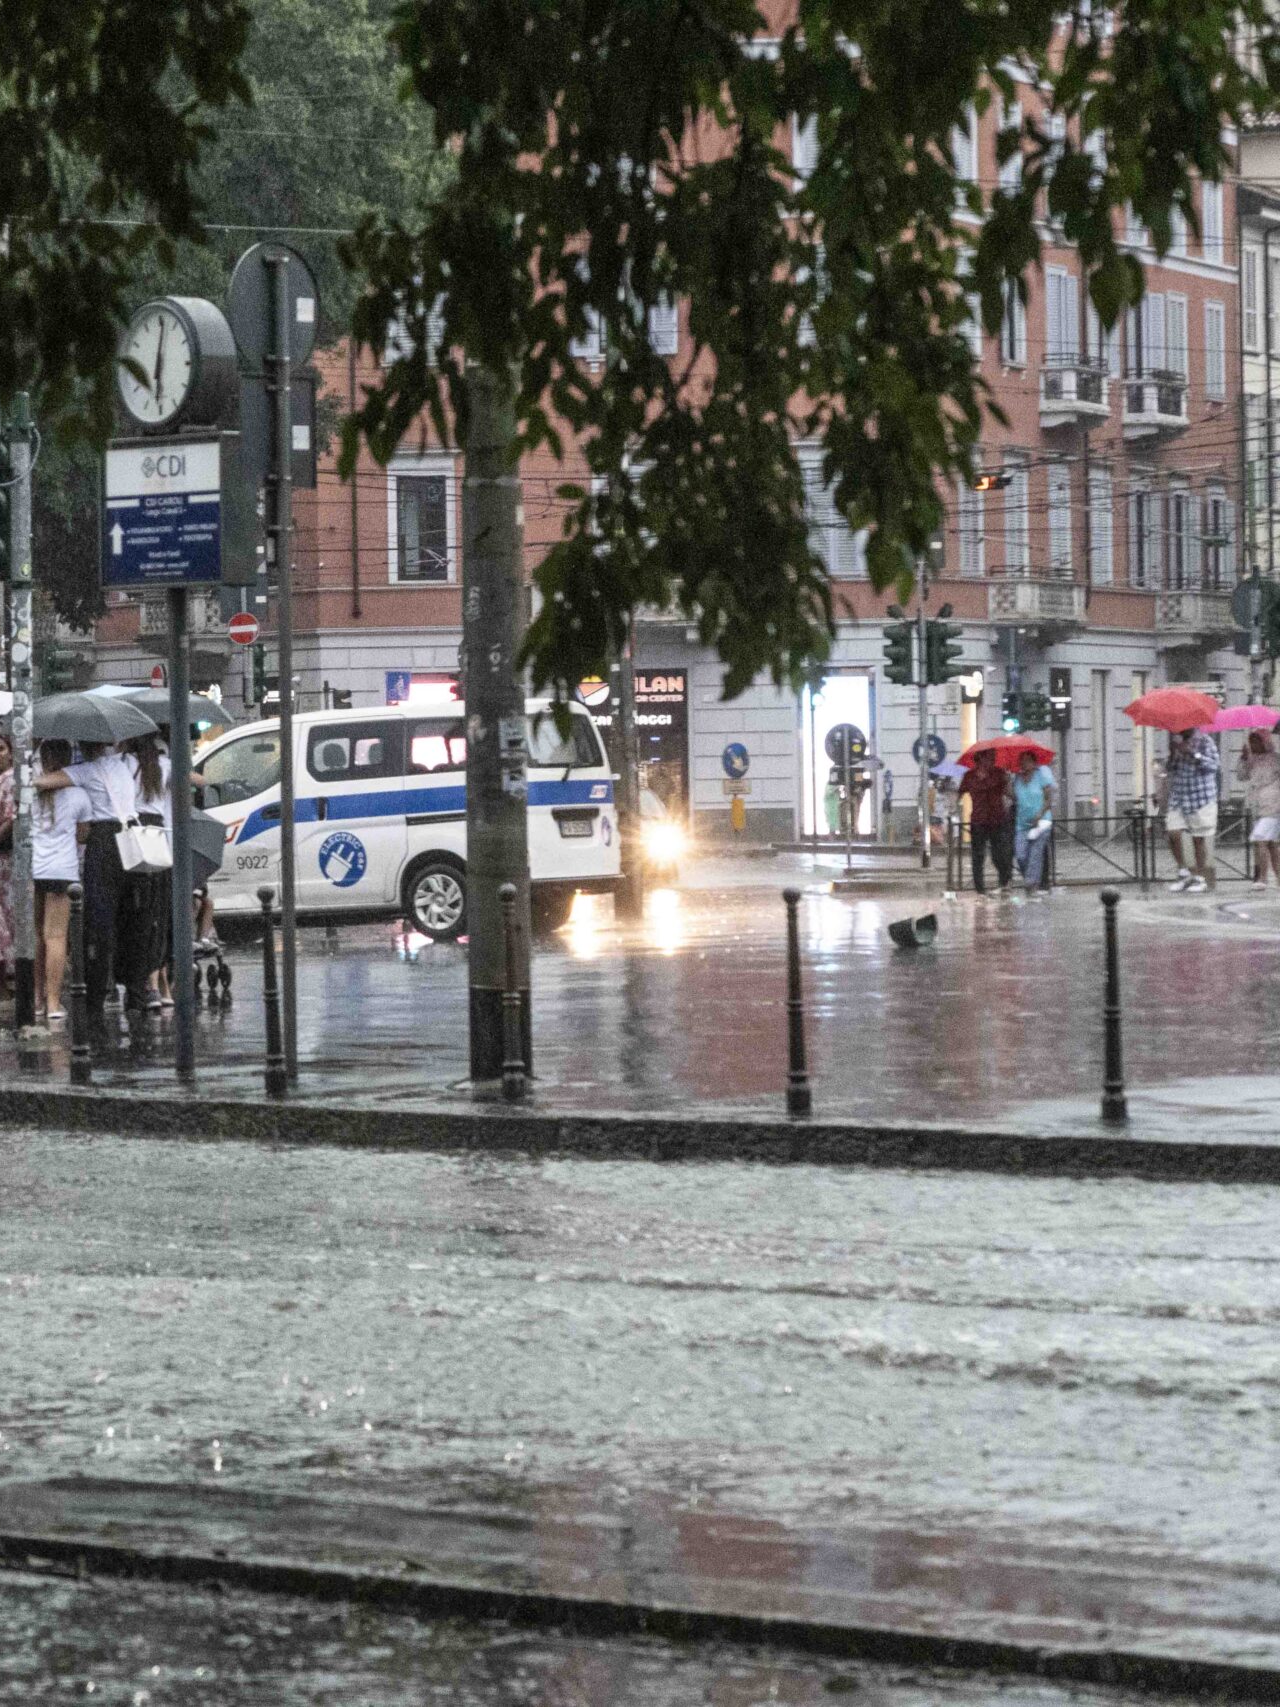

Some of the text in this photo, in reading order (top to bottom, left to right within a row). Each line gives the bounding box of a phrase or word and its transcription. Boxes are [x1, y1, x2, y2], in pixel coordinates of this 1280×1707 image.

[156, 454, 187, 478] CDI
[634, 676, 685, 693] ILAN
[320, 832, 361, 855] ELECTRIC
[236, 855, 269, 870] 9022
